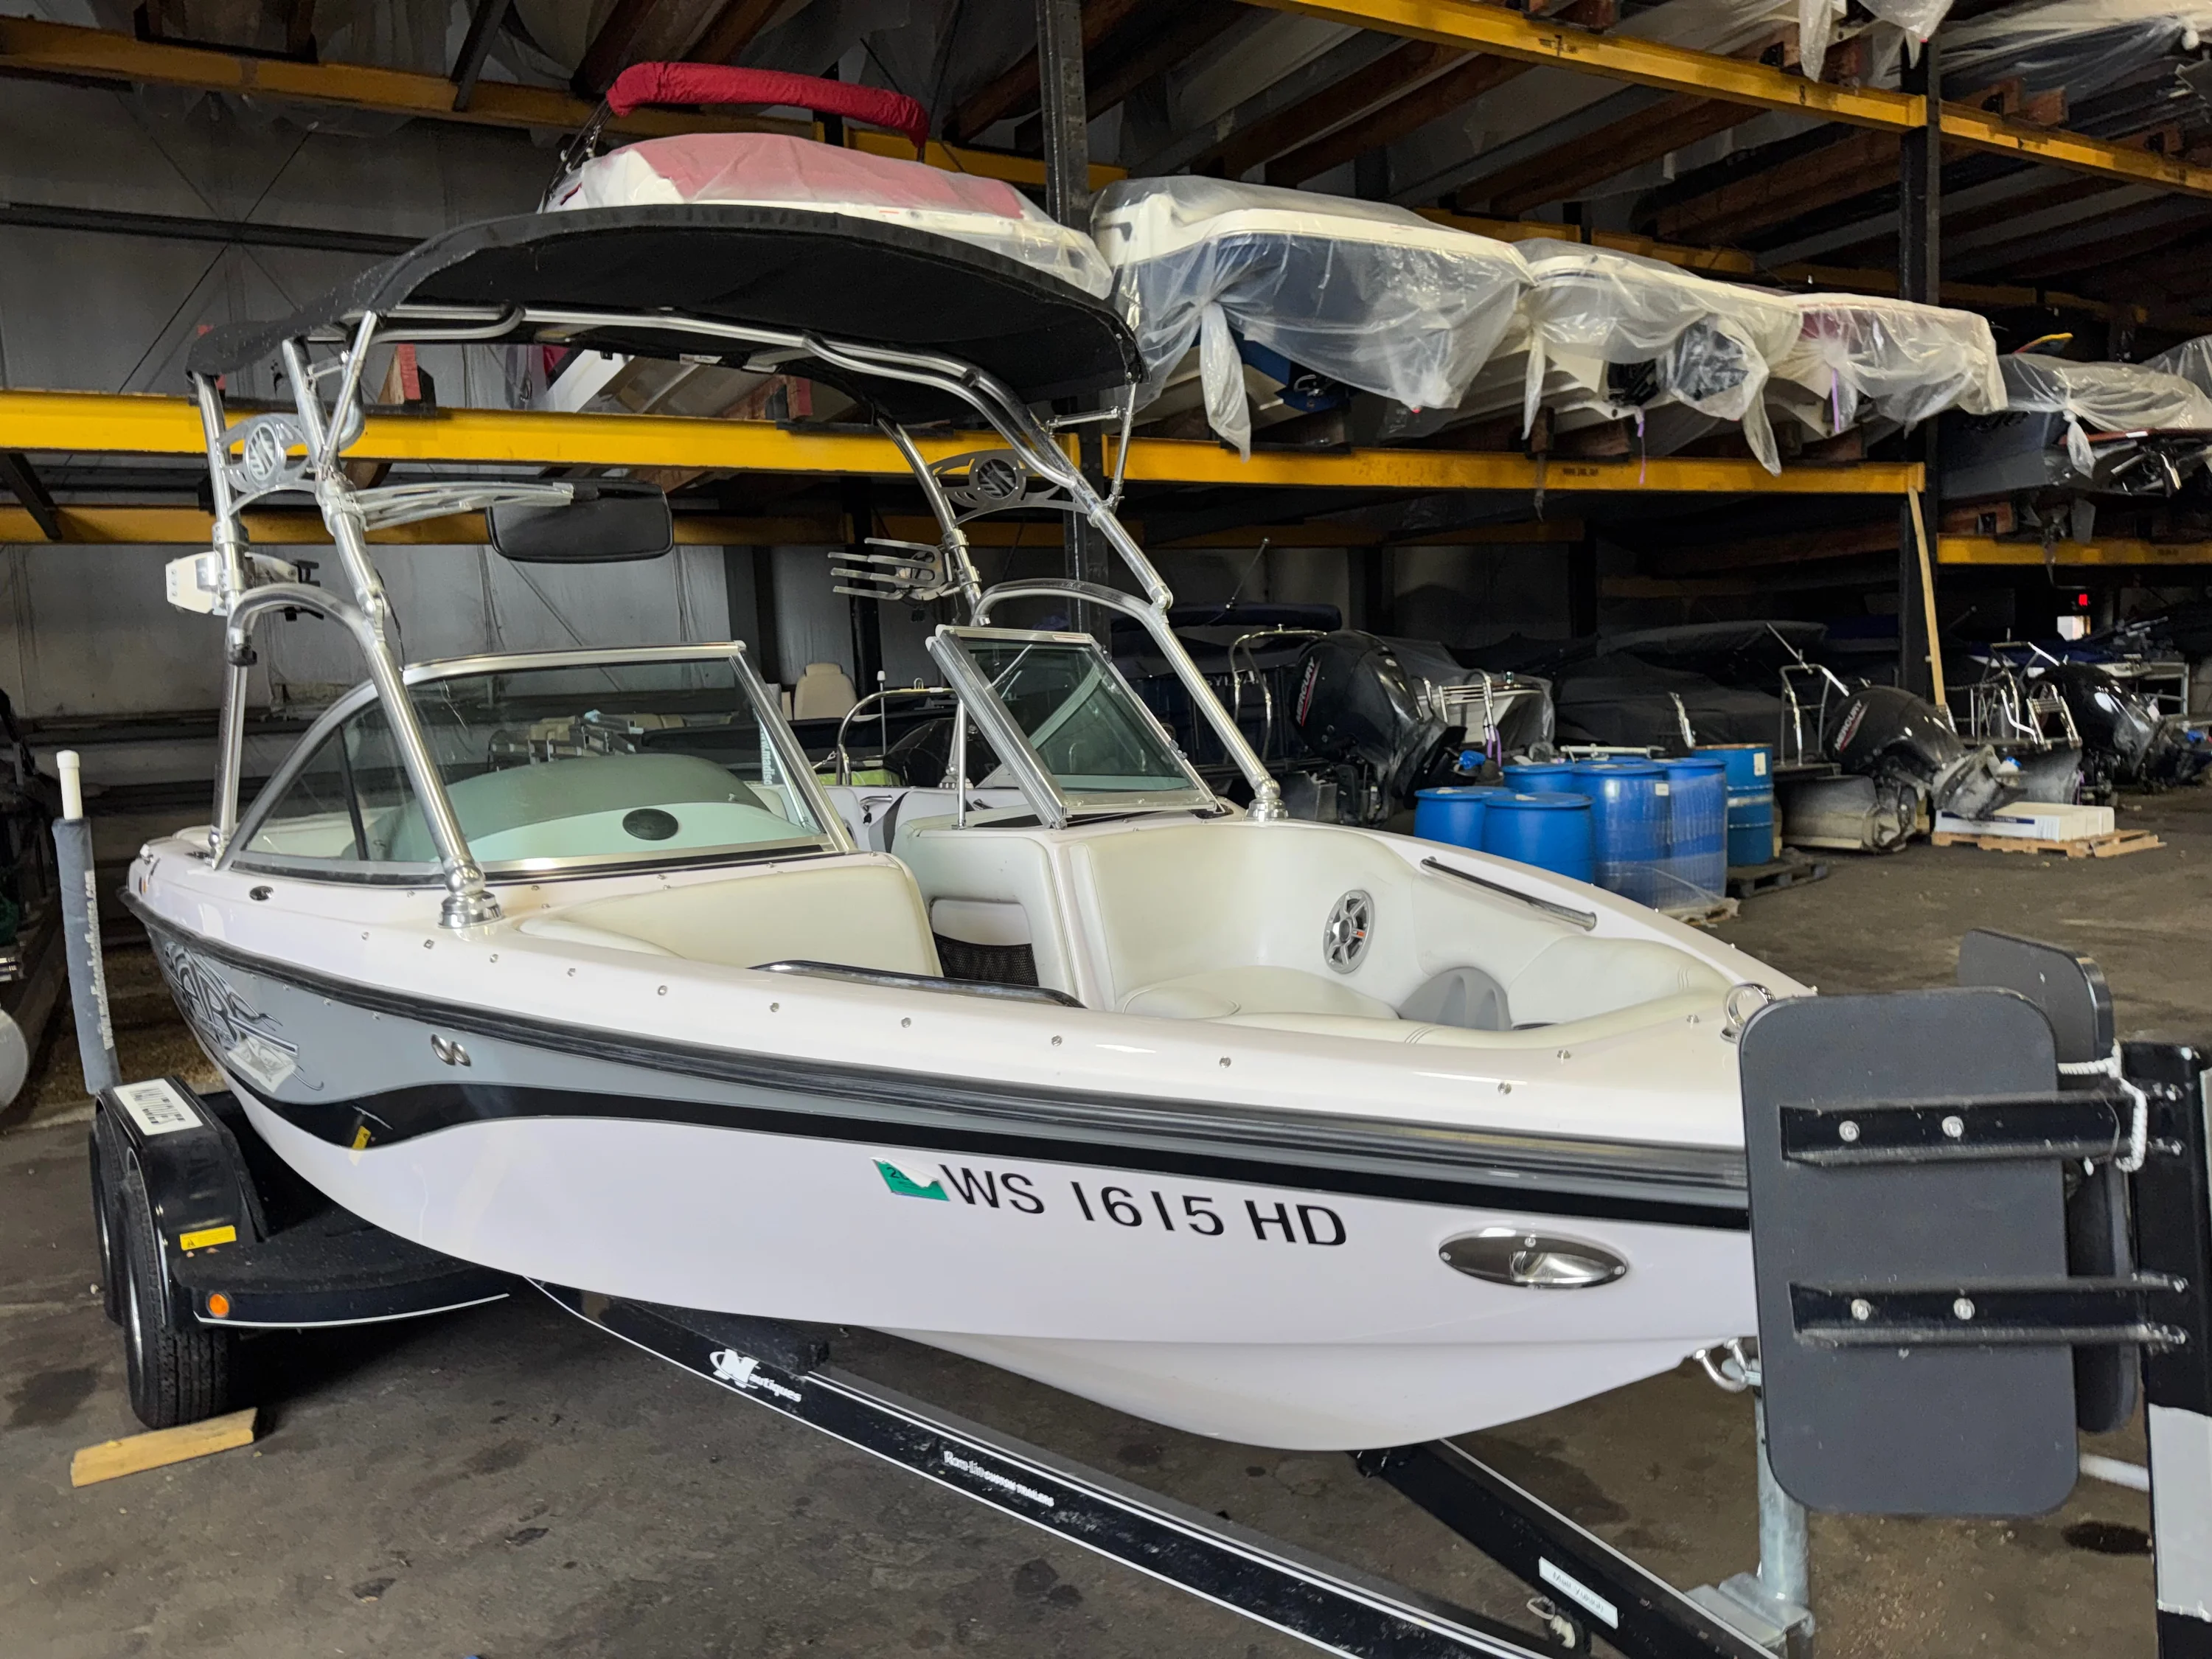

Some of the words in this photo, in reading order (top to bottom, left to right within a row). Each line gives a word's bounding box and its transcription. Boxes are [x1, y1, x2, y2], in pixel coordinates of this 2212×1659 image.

[1295, 655, 1315, 725] MERCURY
[1834, 699, 1863, 751] MERCURY
[938, 1164, 1045, 1214] WS
[1071, 1181, 1224, 1236] 1615
[1244, 1199, 1346, 1247] HD
